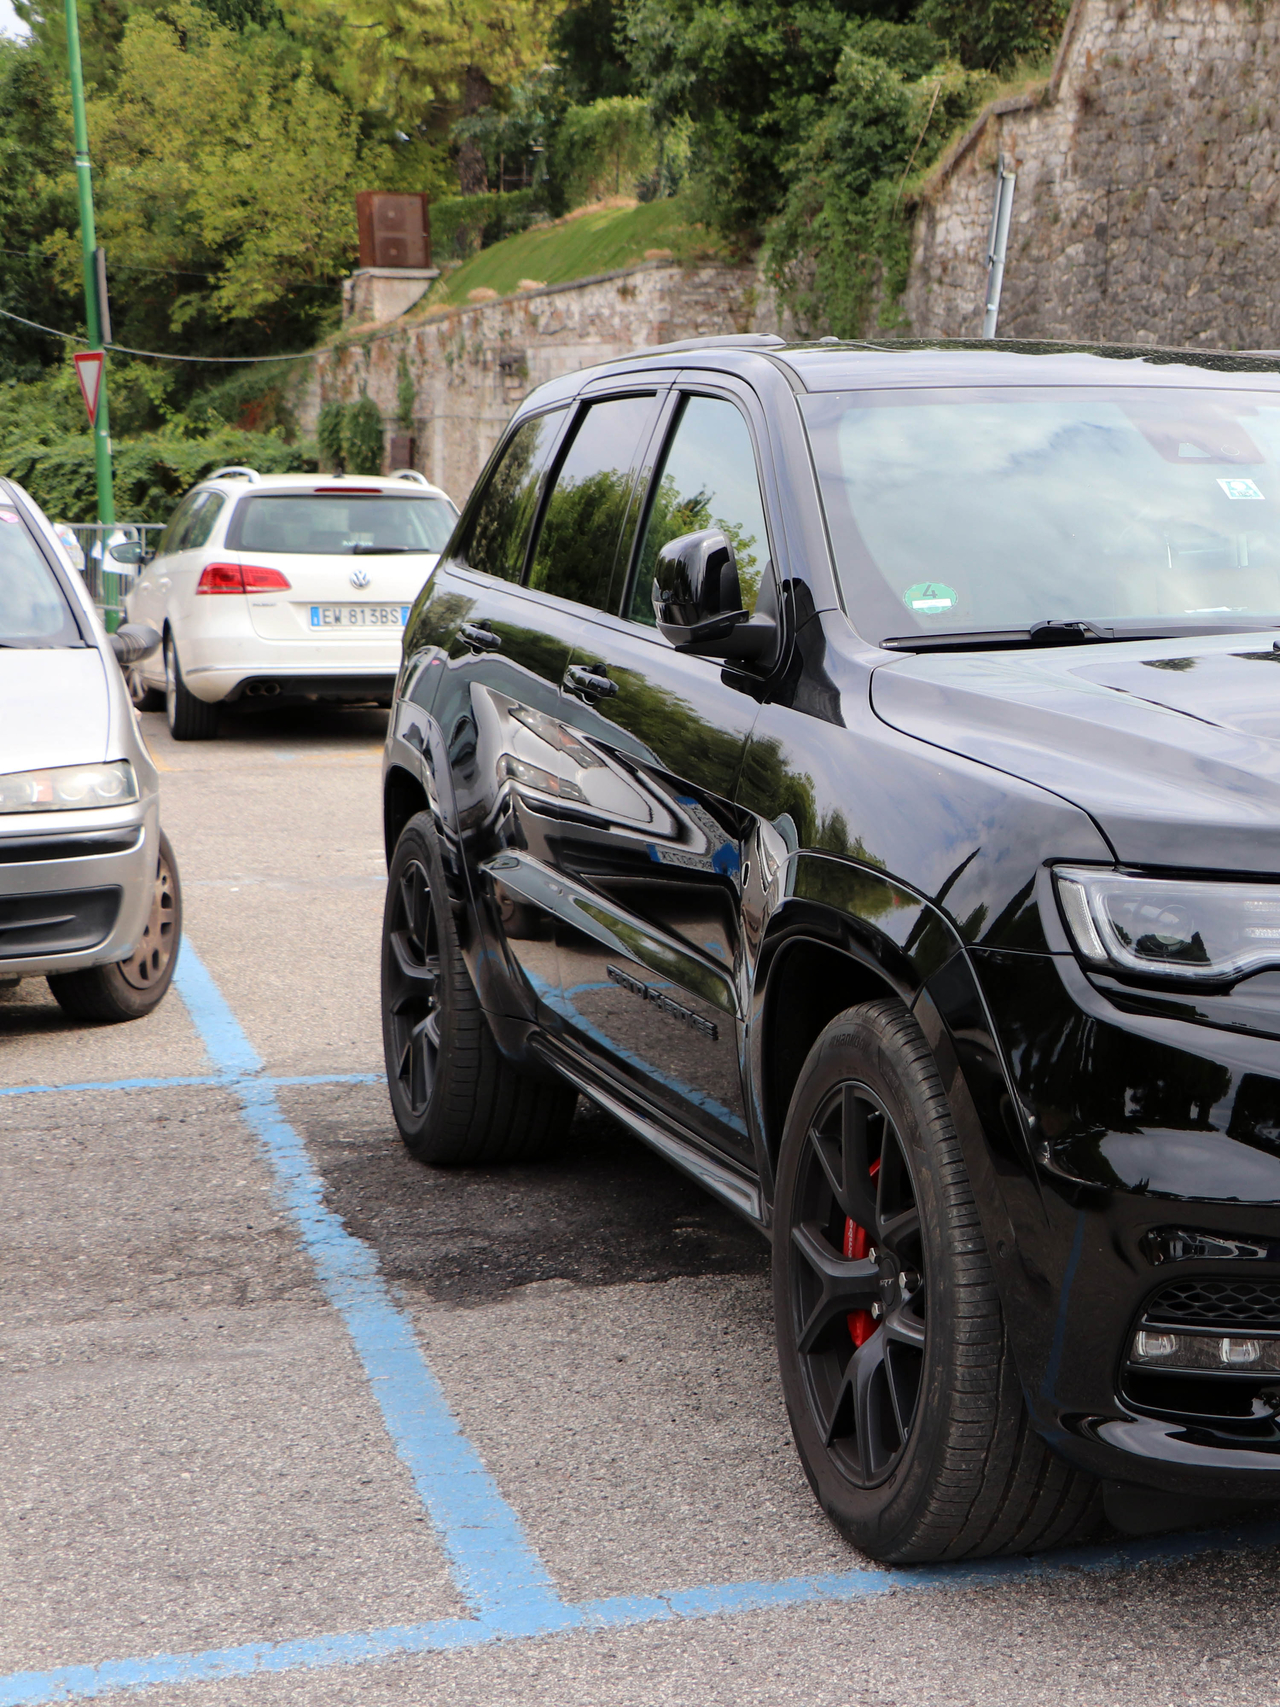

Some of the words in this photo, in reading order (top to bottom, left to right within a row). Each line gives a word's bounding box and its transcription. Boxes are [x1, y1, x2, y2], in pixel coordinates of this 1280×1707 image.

[922, 584, 938, 598] 4
[322, 608, 342, 624] EW
[350, 608, 400, 624] 813BS
